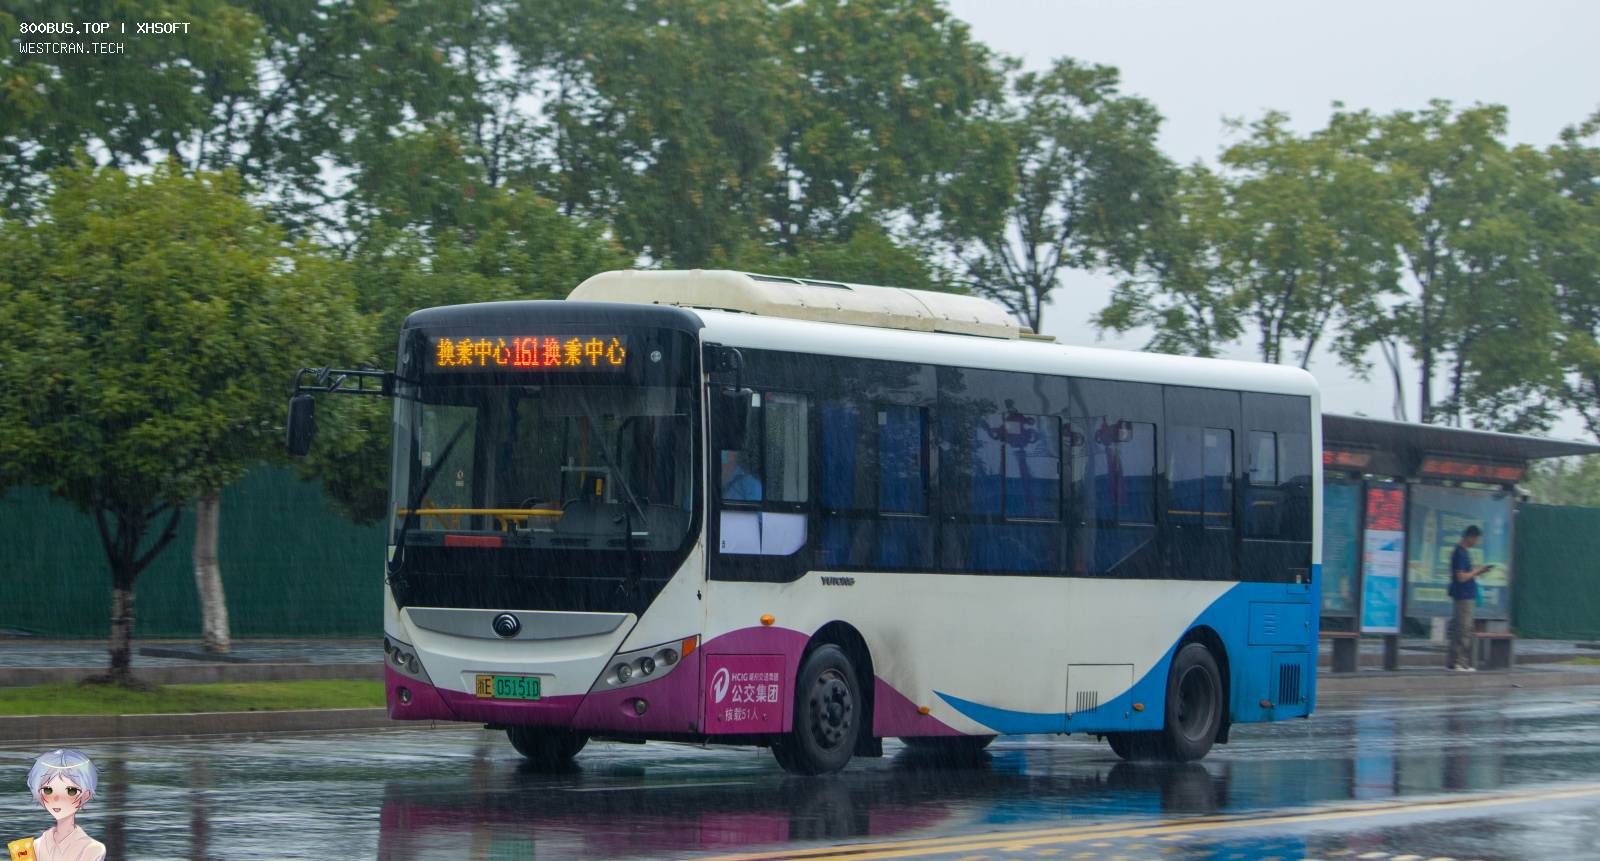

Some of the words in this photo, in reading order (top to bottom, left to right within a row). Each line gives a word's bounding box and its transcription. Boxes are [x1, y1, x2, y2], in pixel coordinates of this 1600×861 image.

[436, 337, 511, 366] 换乘中心
[513, 337, 539, 366] 161
[731, 683, 779, 703] 公交集团
